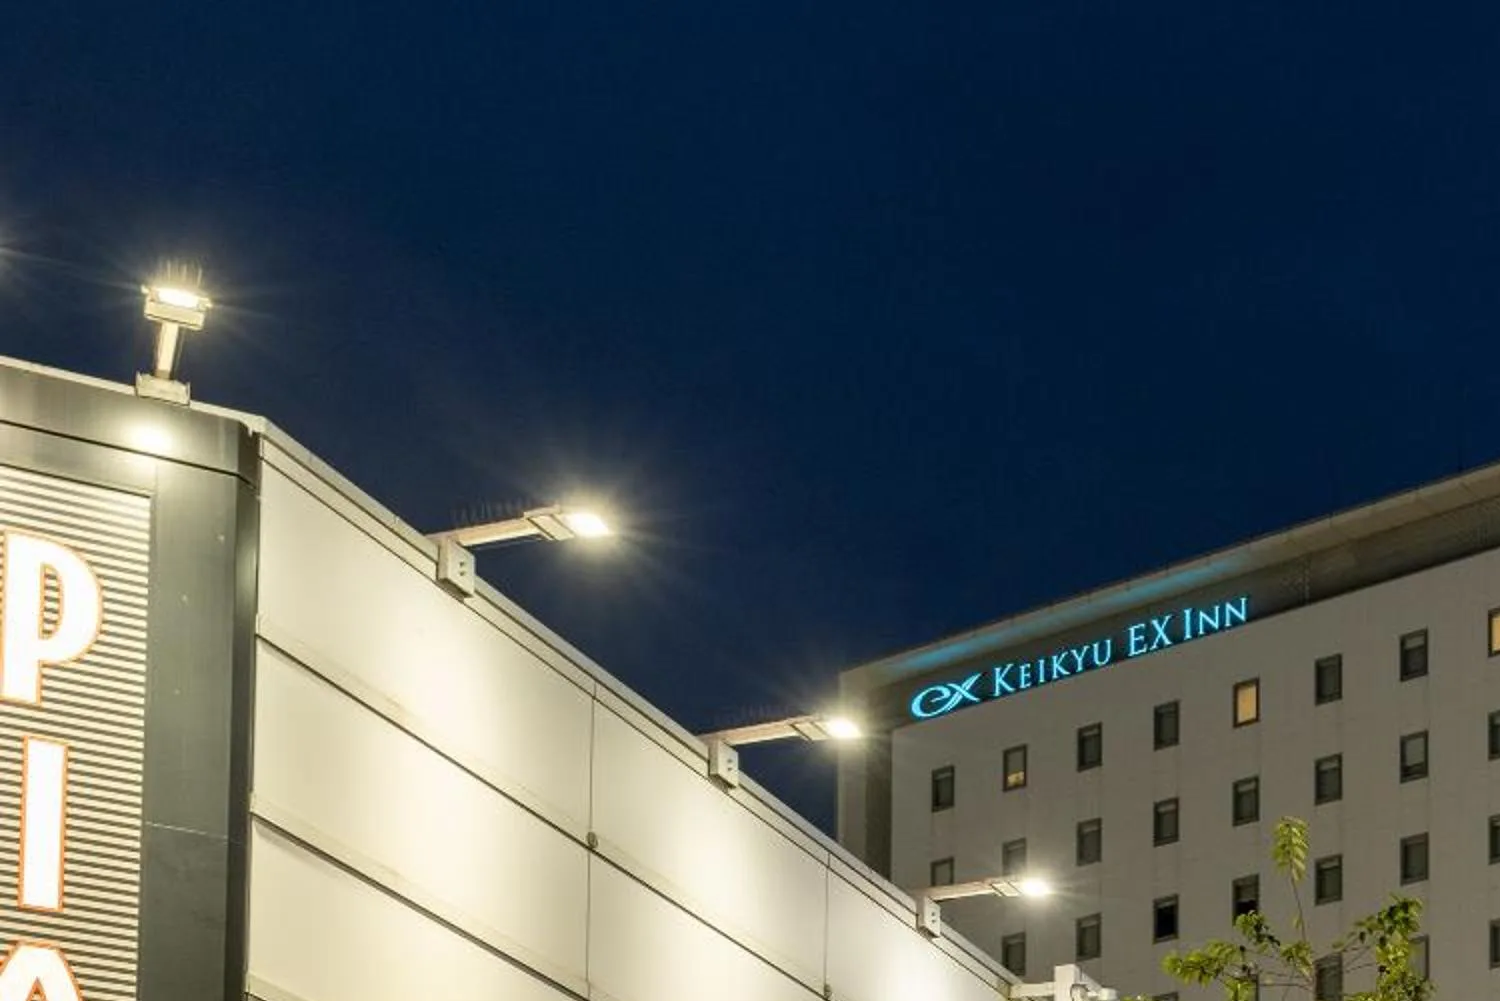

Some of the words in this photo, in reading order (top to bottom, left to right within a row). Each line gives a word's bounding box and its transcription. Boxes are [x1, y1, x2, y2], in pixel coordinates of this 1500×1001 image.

[993, 639, 1112, 697] KEIKYU
[1128, 614, 1173, 657] EX
[1184, 597, 1248, 641] INN
